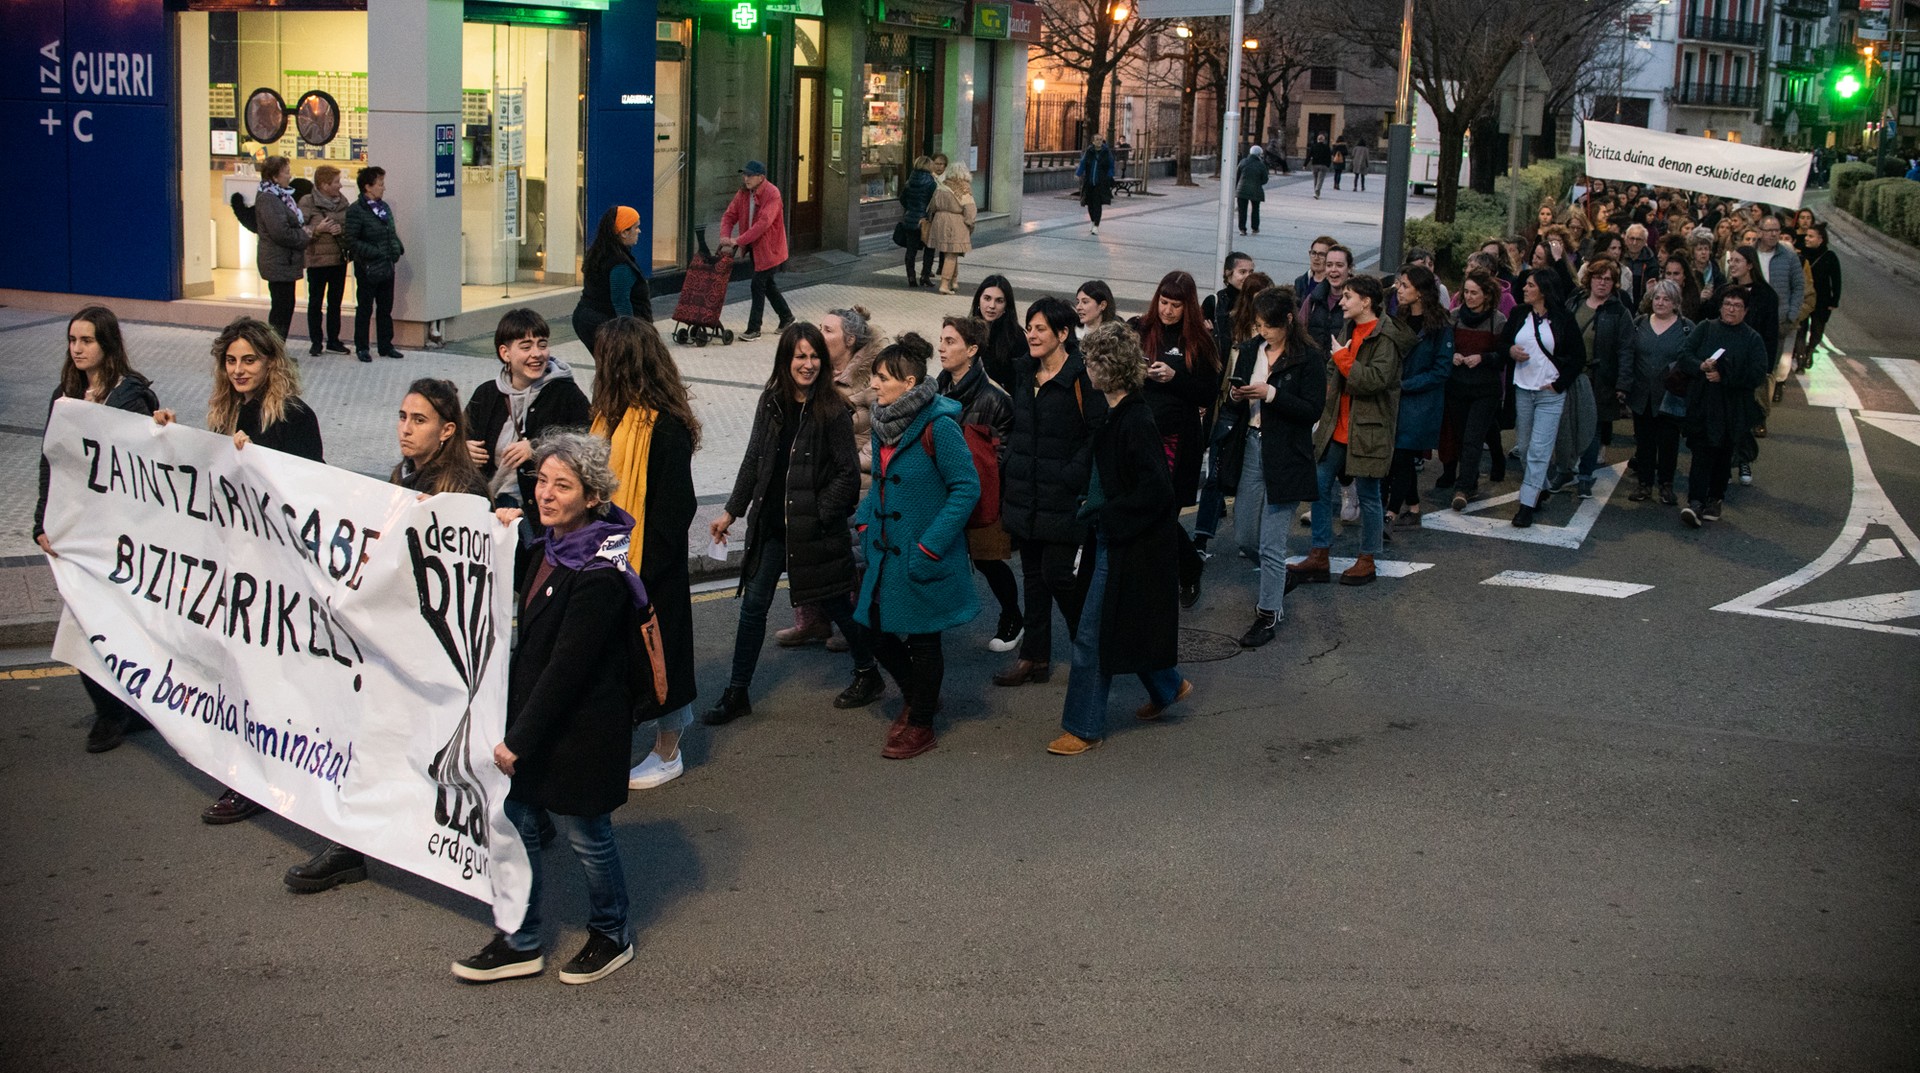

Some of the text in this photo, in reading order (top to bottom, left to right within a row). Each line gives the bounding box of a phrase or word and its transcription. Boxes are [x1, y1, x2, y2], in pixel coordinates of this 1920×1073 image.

[40, 40, 61, 95] IZA
[73, 52, 152, 97] GUERRI
[72, 109, 94, 143] C
[1587, 140, 1798, 192] Bizitza duina denon eskubidea delako
[82, 437, 286, 546] ZAINTZARIK
[425, 511, 491, 566] denon
[109, 534, 301, 656] BIZITZARIK
[152, 658, 239, 736] borroka
